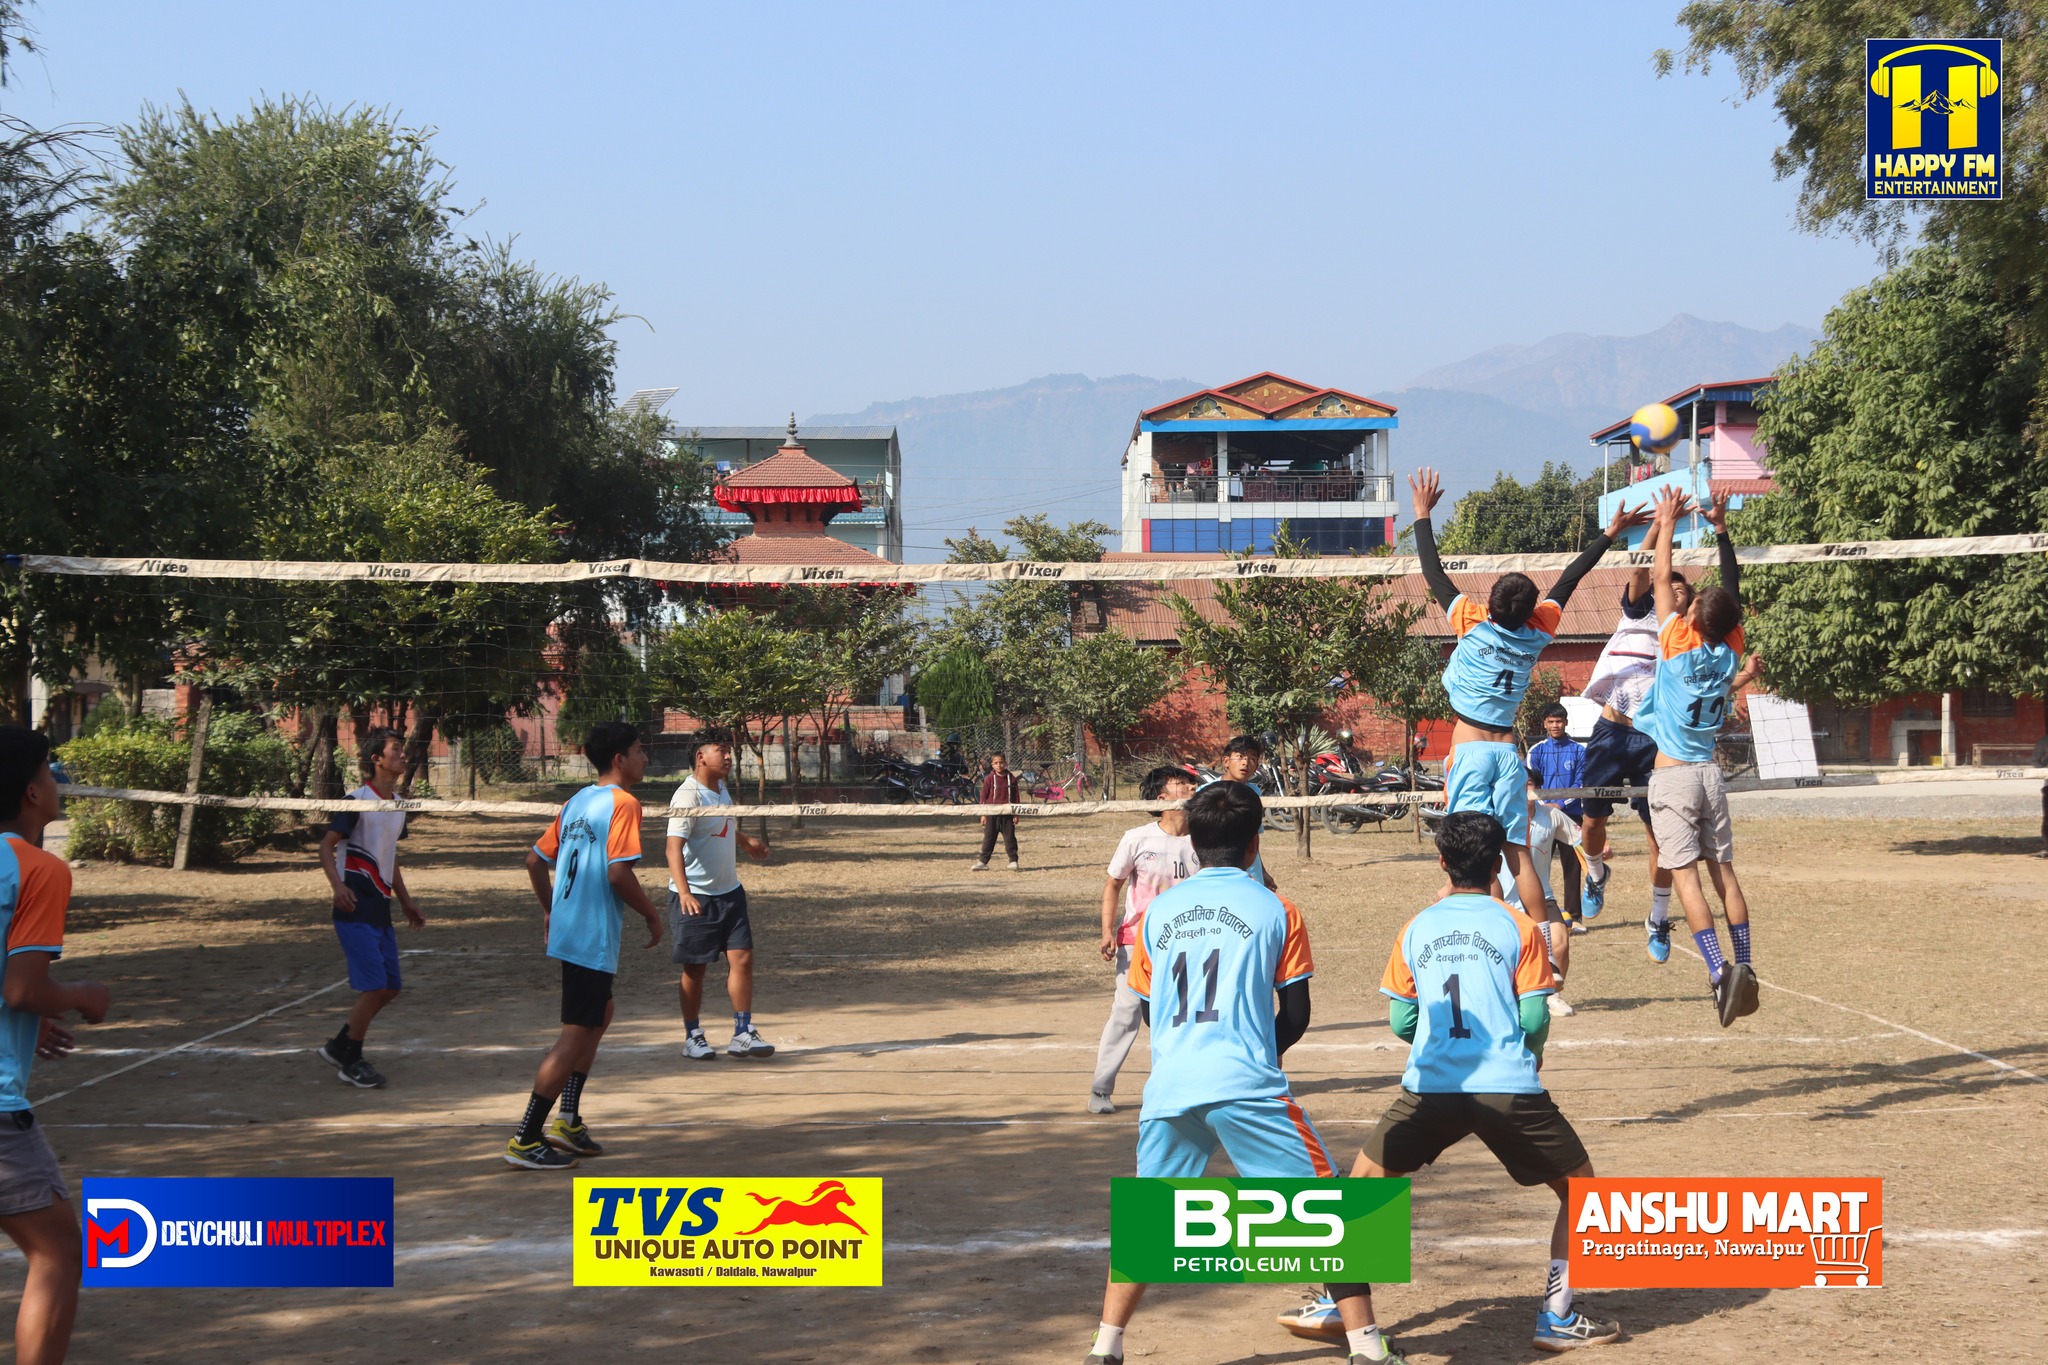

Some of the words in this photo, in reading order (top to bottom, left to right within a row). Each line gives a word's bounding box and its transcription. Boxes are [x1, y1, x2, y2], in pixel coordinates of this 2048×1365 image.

[2029, 536, 2048, 549] Vi
[1823, 545, 1868, 557] Vixen
[1440, 558, 1469, 571] xen
[1628, 552, 1656, 566] Vix
[365, 564, 411, 578] Vixen
[588, 562, 631, 574] Vixen
[801, 567, 844, 580] Vixen
[1017, 563, 1062, 578] Vixen
[1236, 562, 1277, 575] Vixen
[1795, 778, 1822, 787] Vixen
[1395, 793, 1423, 802] Vixen
[1594, 787, 1622, 797] Vixen
[394, 800, 421, 809] Vixen
[799, 805, 827, 815] Vixen
[1010, 805, 1038, 815] Vixen
[563, 848, 579, 899] 9
[1173, 861, 1185, 879] 10
[1156, 922, 1173, 951] पृथ्वी
[1416, 943, 1434, 970] पृथ्वी
[1172, 949, 1220, 1028] 11
[1442, 973, 1471, 1039] 1
